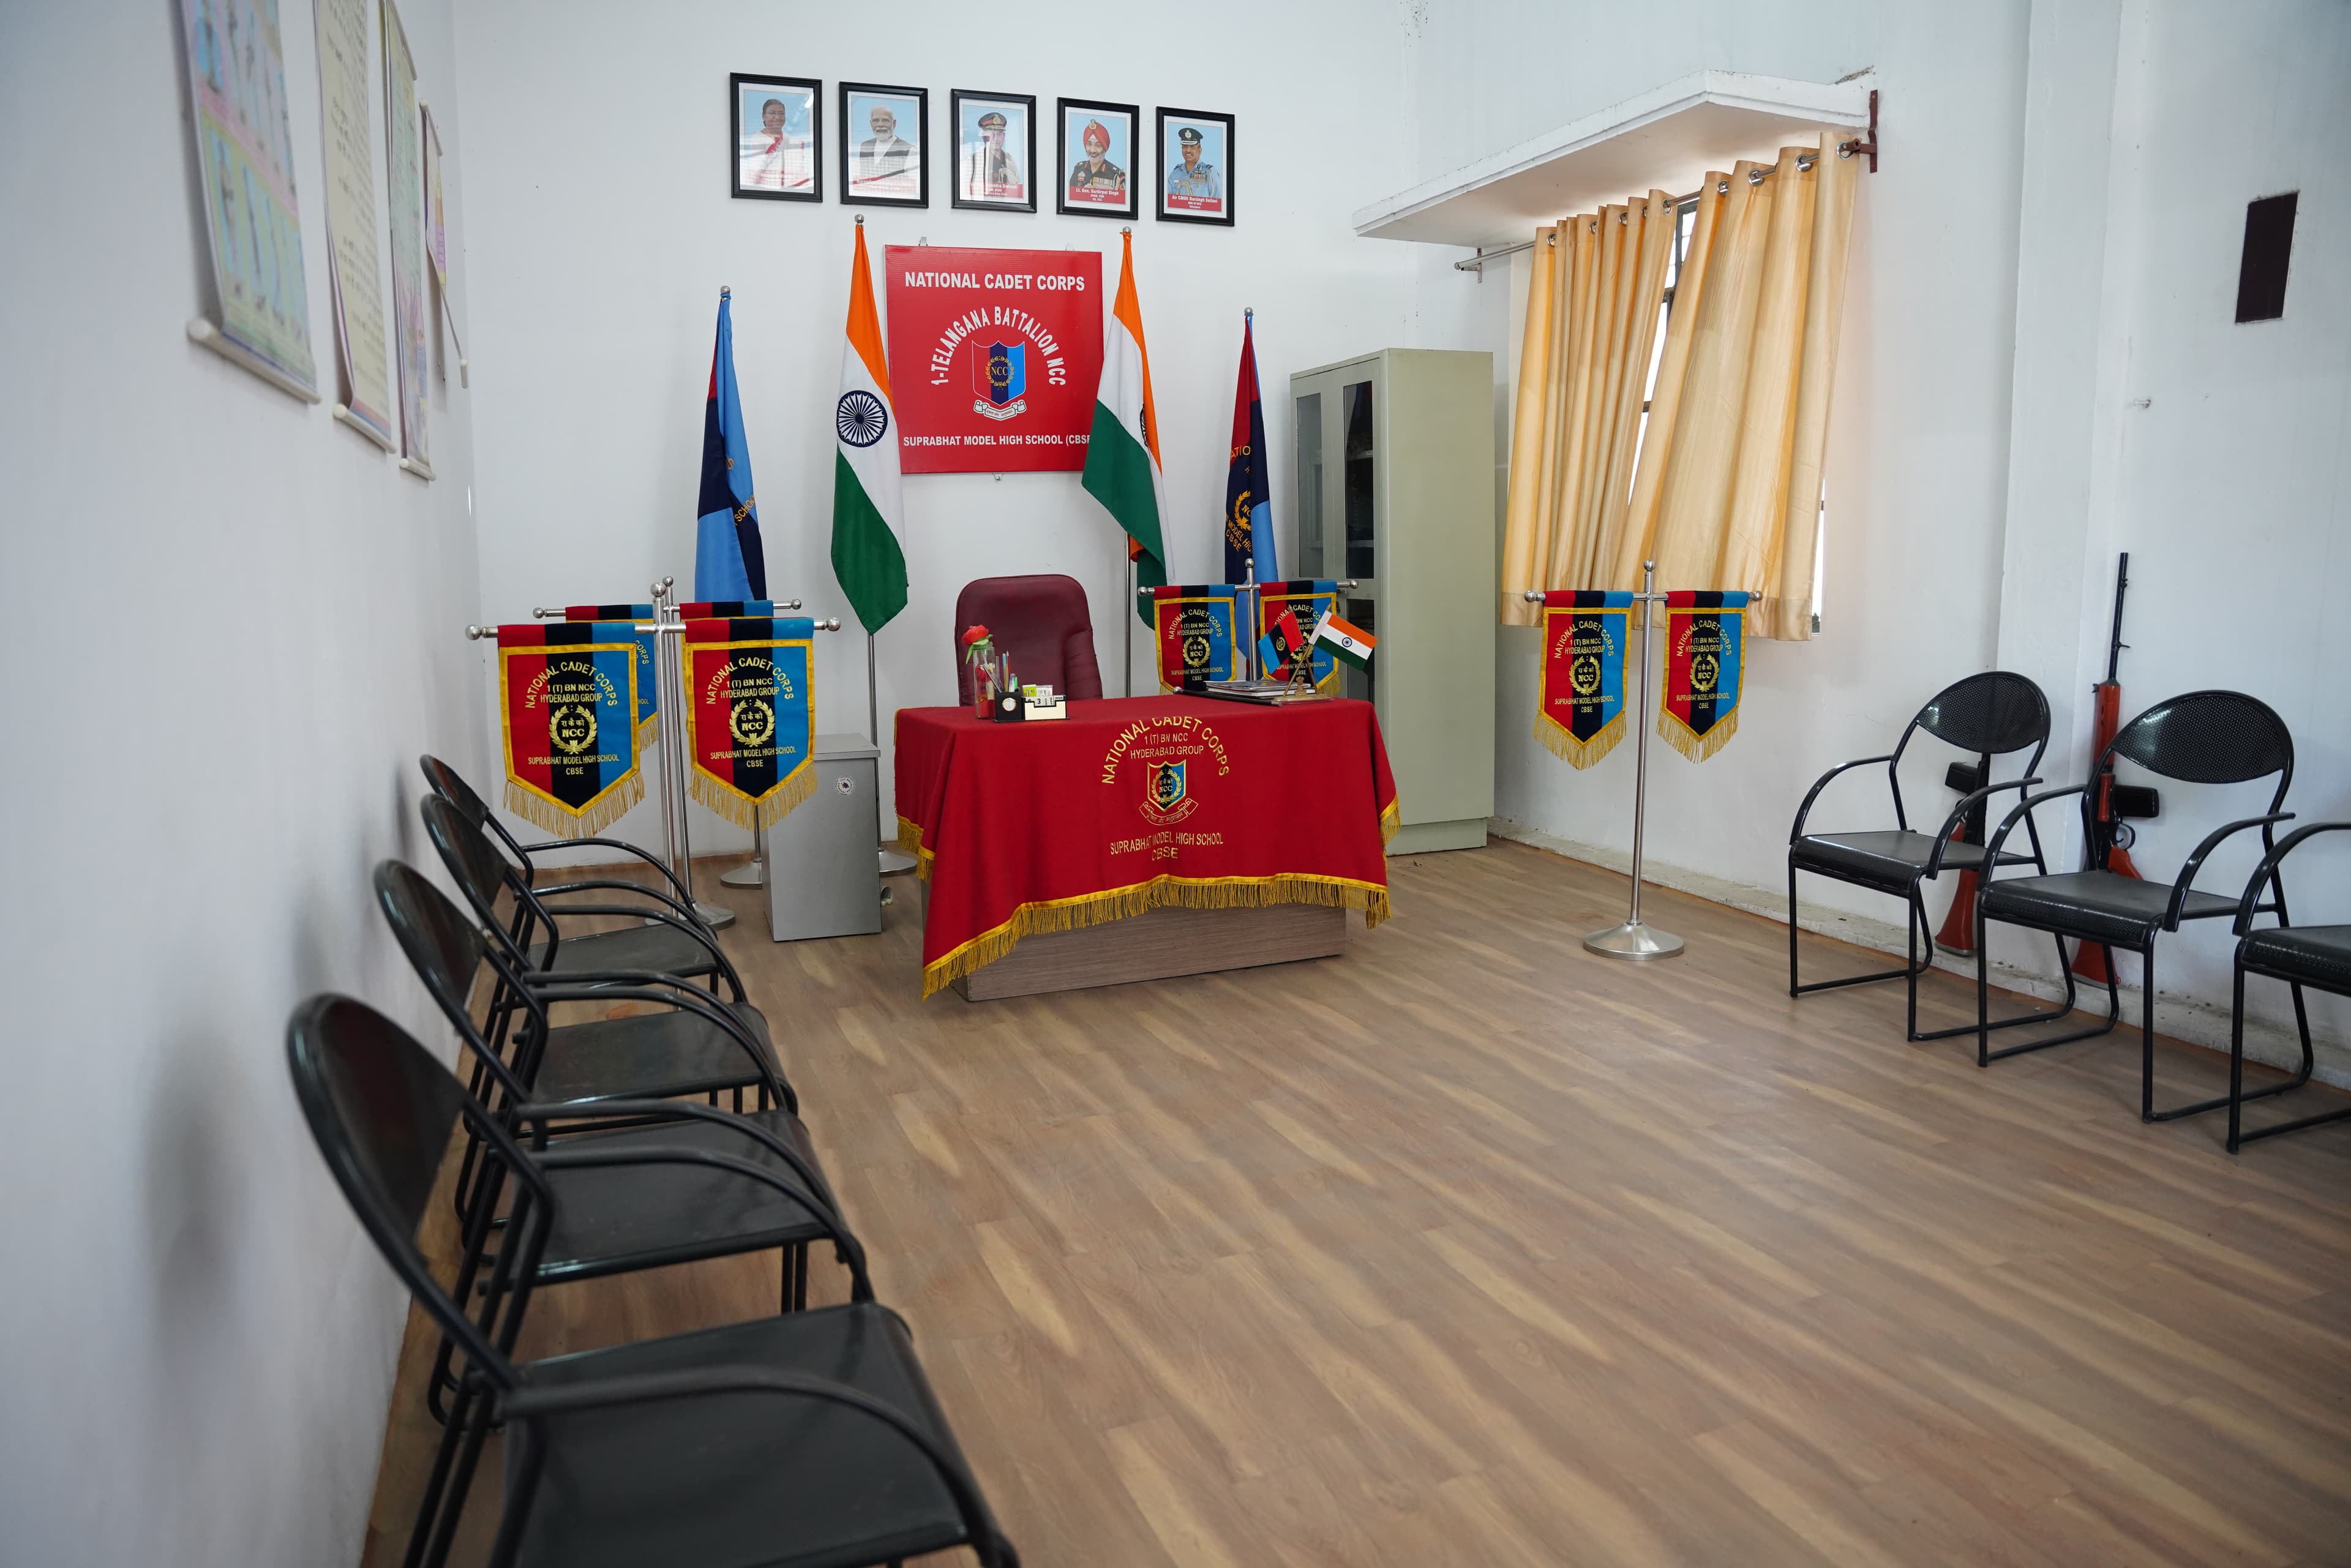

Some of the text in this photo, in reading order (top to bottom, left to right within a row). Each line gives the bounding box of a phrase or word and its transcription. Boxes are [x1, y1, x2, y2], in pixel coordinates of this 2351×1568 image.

[905, 272, 1085, 291] NATIONAL CADET CORPS
[931, 306, 1066, 386] 1-TELANGANA BATTALION NCC
[991, 366, 1008, 376] NCC
[904, 435, 1090, 446] SUPRABHAT MODEL HIGH SCHOOL (CBS
[1226, 529, 1242, 552] CBSE
[1228, 520, 1252, 553] MODEL HIG
[1169, 612, 1187, 639] NATIONAL
[1209, 616, 1223, 637] CORPS
[1554, 621, 1614, 658] NATIONAL CADET CORPS
[1677, 620, 1732, 656] NATIONAL CADET CORPS
[525, 661, 617, 708] NATIONAL CADET CORPS
[706, 657, 794, 704] NATIONAL CADET CORPS
[732, 680, 741, 689] (T)
[743, 678, 754, 687] BN
[552, 684, 563, 694] (T)
[721, 687, 779, 699] HYDERABAD GROUP
[540, 692, 602, 703] HYDERABAD GROUP
[562, 729, 584, 737] NCC
[741, 722, 763, 730] NCC
[1144, 733, 1188, 745] 1 (T) BN NCC
[710, 750, 742, 759] SUPRABHAT
[762, 748, 774, 756] HIGH
[775, 746, 796, 754] SCHOOL
[1102, 716, 1229, 784] NATIONAL CADET CORPS
[1131, 745, 1204, 759] HYDERABAD GROUP
[563, 756, 582, 764] MODEL
[583, 755, 596, 763] HIGH
[1111, 831, 1223, 855] SUPRABHAT MODEL HIGH SCHOOL
[1152, 846, 1179, 861] CBSE
